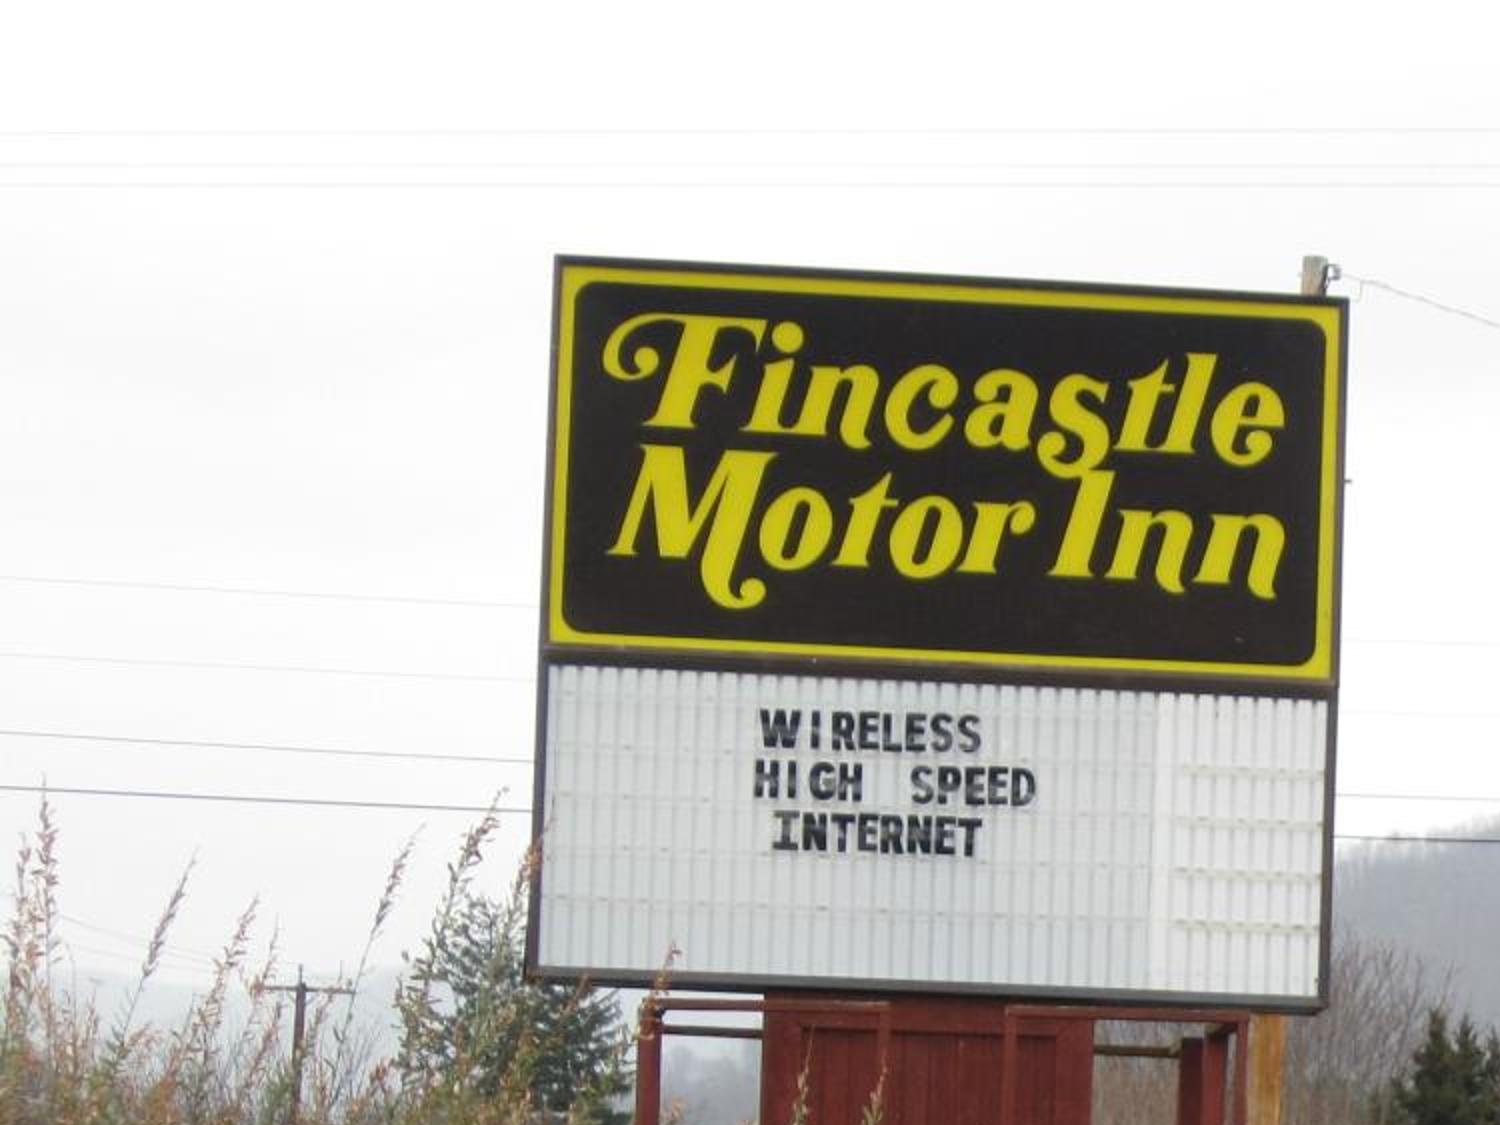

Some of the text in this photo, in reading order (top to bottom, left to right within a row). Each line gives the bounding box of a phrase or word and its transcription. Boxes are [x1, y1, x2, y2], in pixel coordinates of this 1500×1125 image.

[602, 312, 1286, 479] Fincastle
[606, 444, 1286, 610] Motor Inn
[759, 708, 982, 754] WIRELESS
[753, 759, 1036, 808] HIGH SPEED
[772, 810, 984, 858] INTERNET
